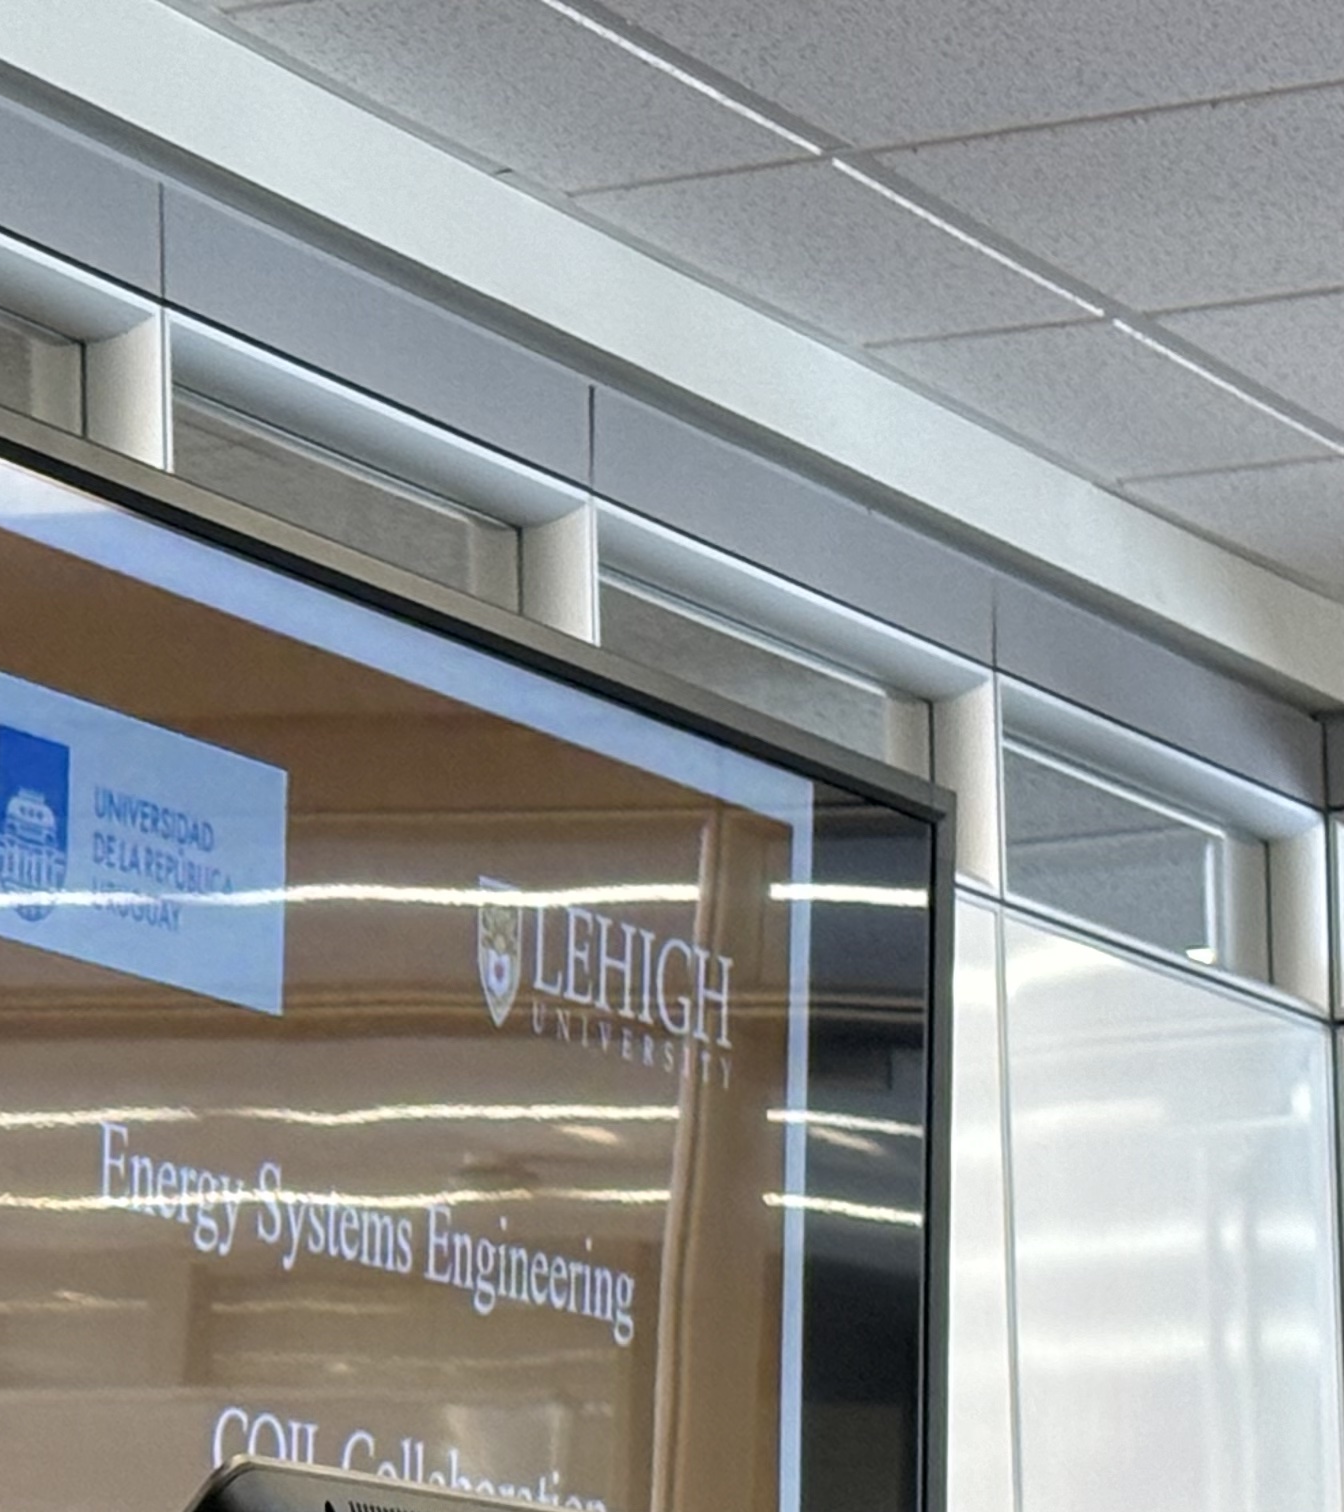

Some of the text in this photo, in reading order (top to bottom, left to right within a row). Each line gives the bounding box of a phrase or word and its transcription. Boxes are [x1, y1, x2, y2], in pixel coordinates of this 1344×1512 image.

[93, 832, 117, 868] DE
[118, 840, 141, 874] LA
[94, 786, 214, 852] UNIVERSIDAD
[533, 903, 733, 1048] LEHIGH
[532, 1000, 732, 1089] UNIVERSITY
[99, 1121, 634, 1346] Energy Systems Engineering
